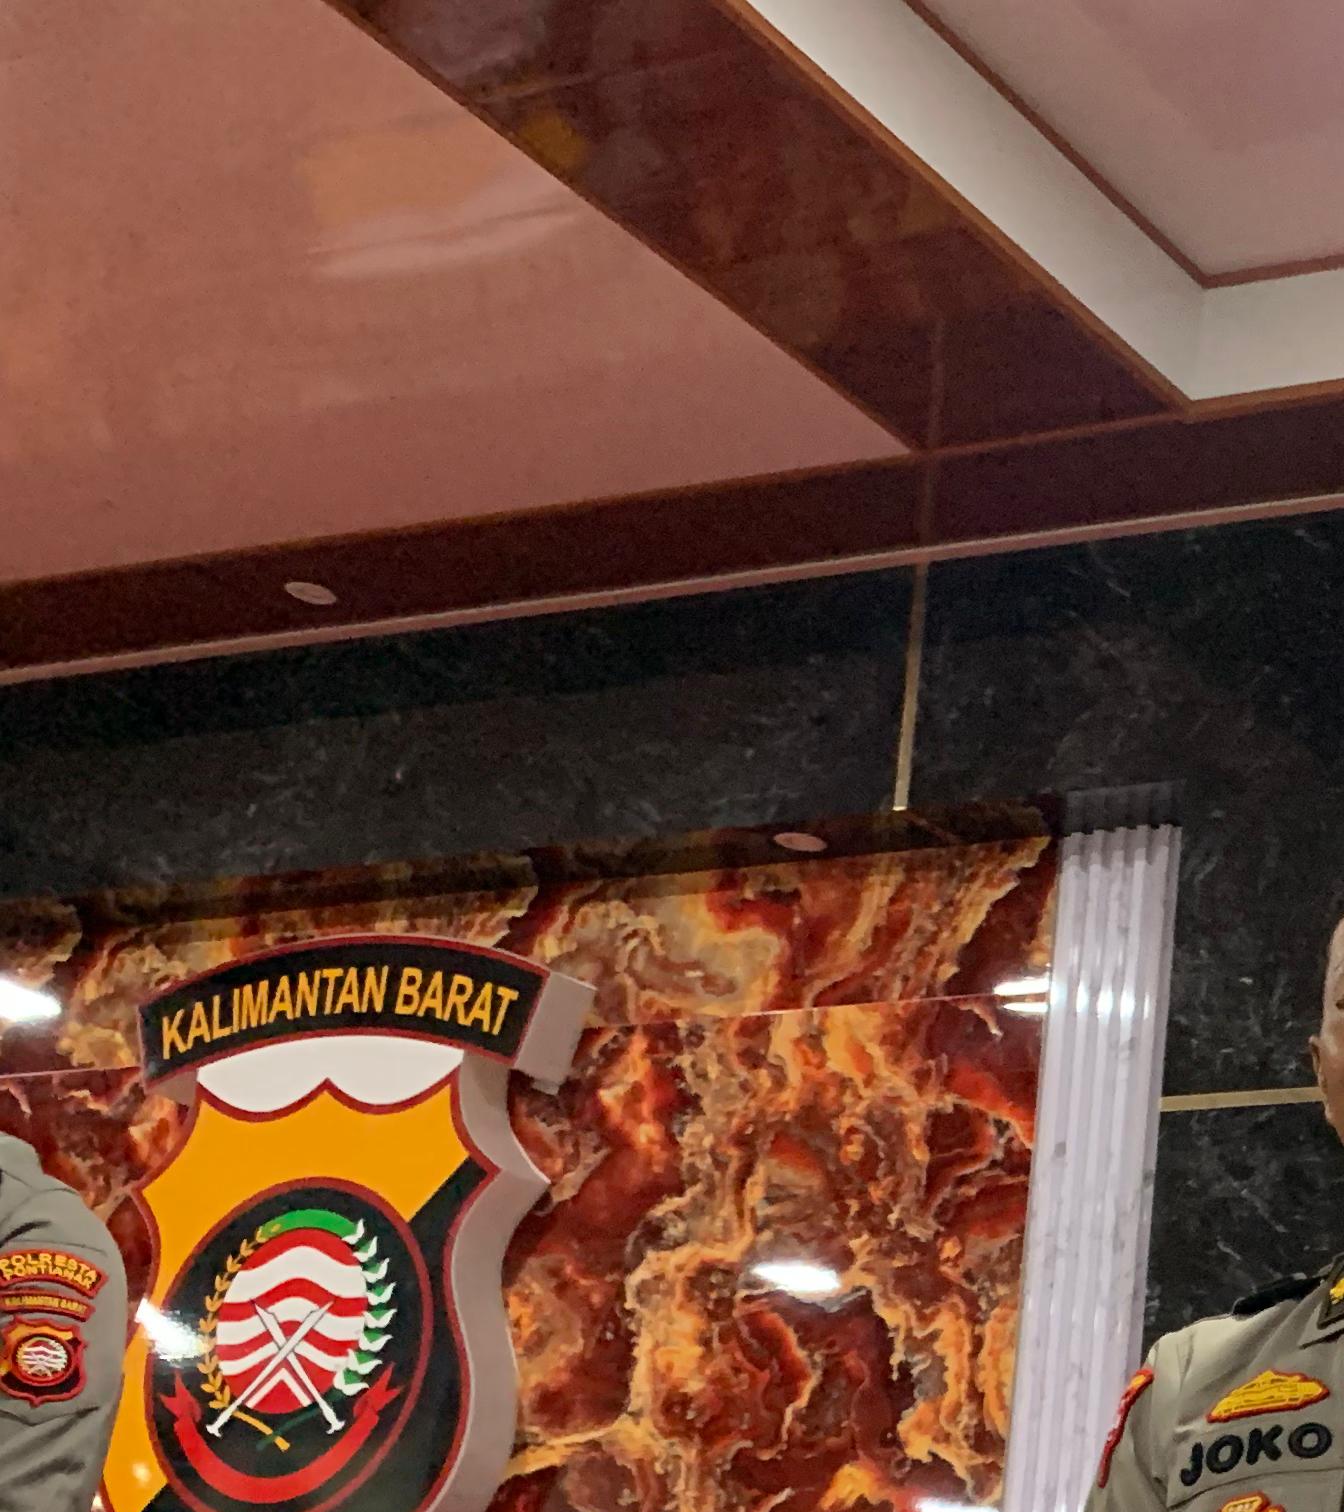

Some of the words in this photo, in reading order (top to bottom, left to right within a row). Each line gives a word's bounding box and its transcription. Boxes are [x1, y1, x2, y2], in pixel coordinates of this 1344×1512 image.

[161, 965, 389, 1060] KALIMANTAN
[394, 967, 519, 1035] BARAT
[0, 1252, 98, 1283] POLRESTA
[1180, 1422, 1332, 1486] JOKO
